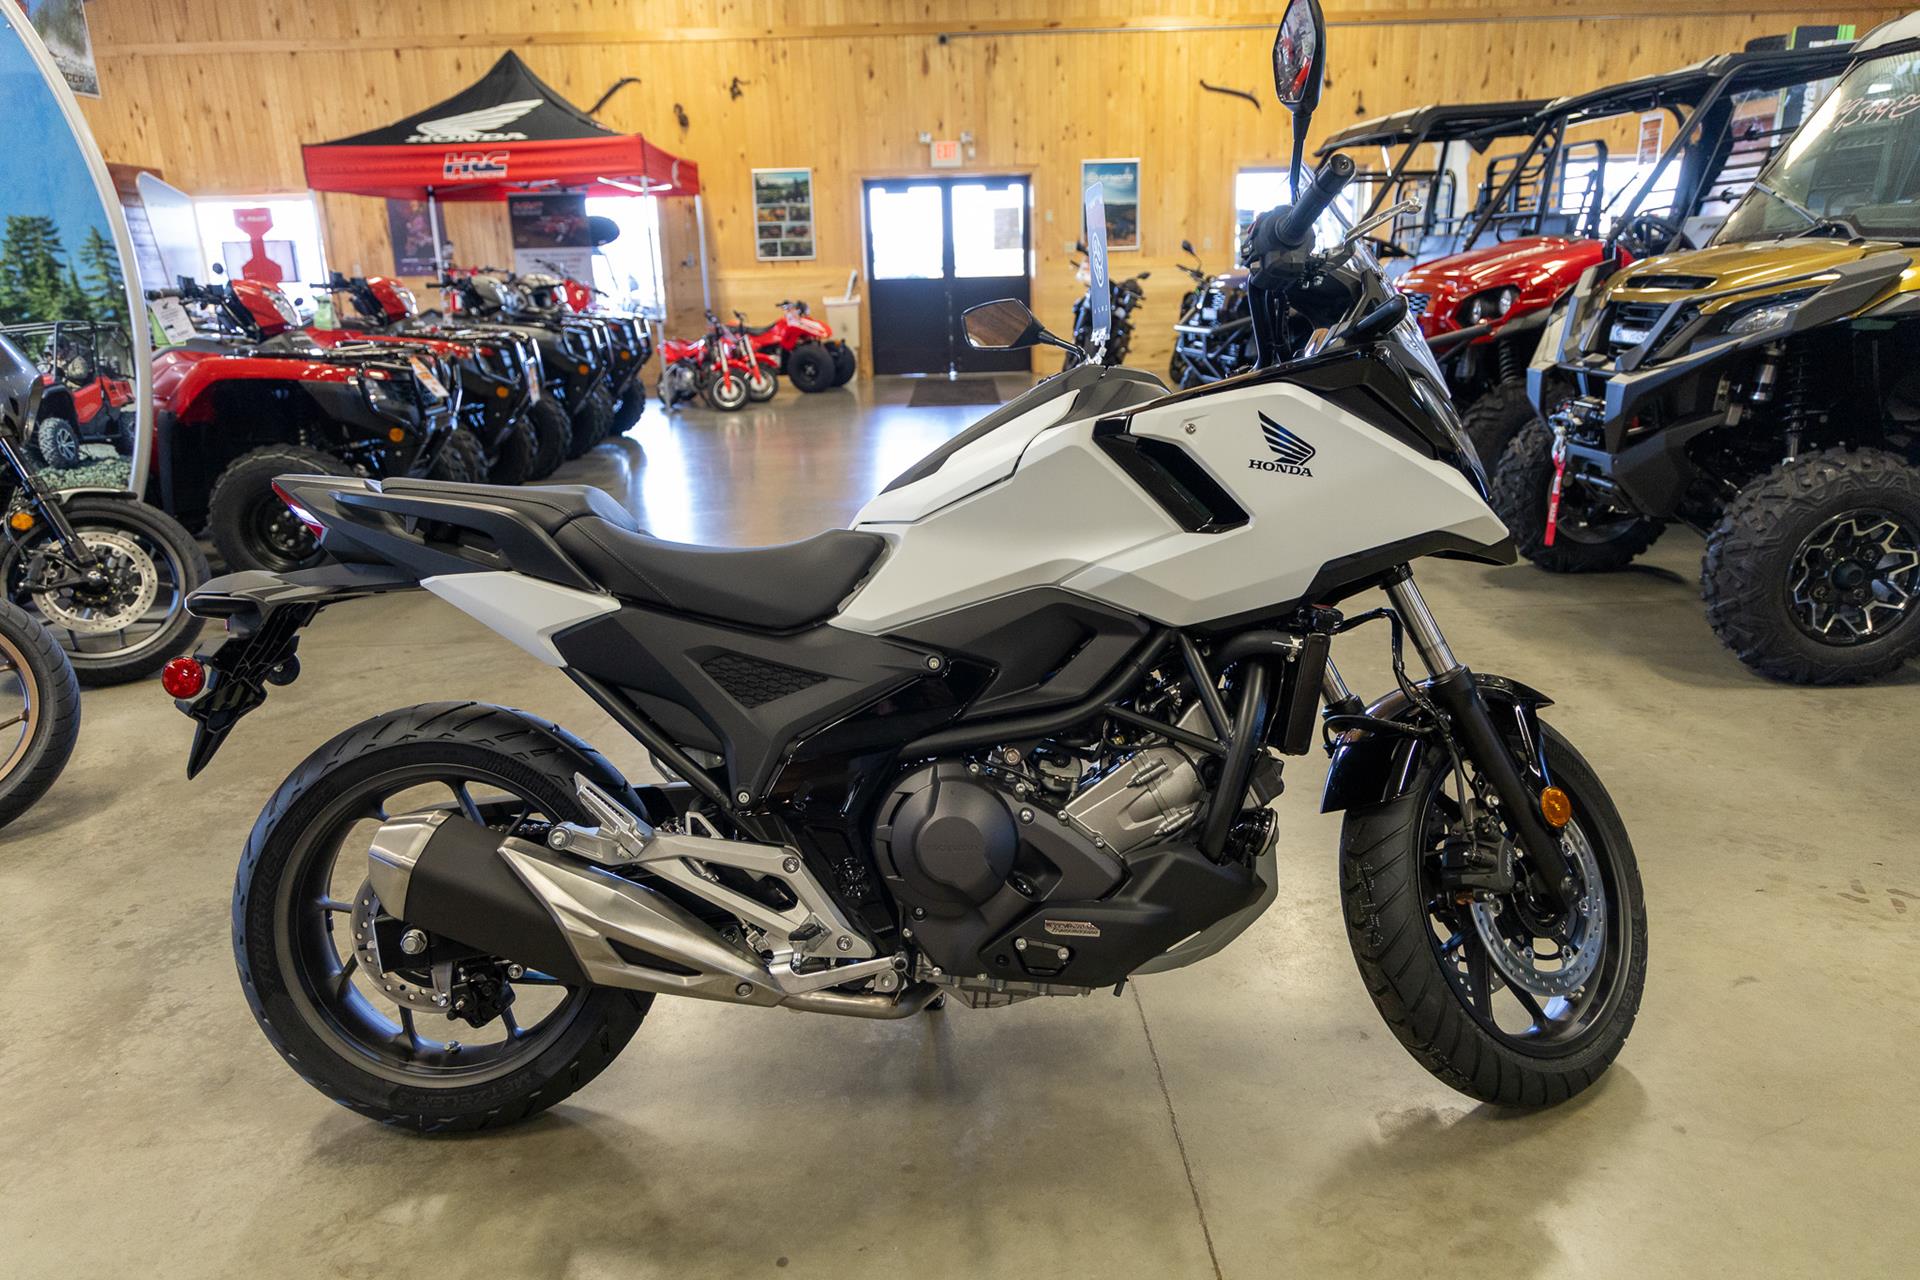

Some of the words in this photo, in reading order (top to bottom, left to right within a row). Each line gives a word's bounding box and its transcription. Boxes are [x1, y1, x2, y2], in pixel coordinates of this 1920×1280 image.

[404, 132, 528, 144] HONDA
[935, 141, 957, 160] EXIT
[443, 150, 511, 175] HRC
[1248, 459, 1313, 478] HONDA
